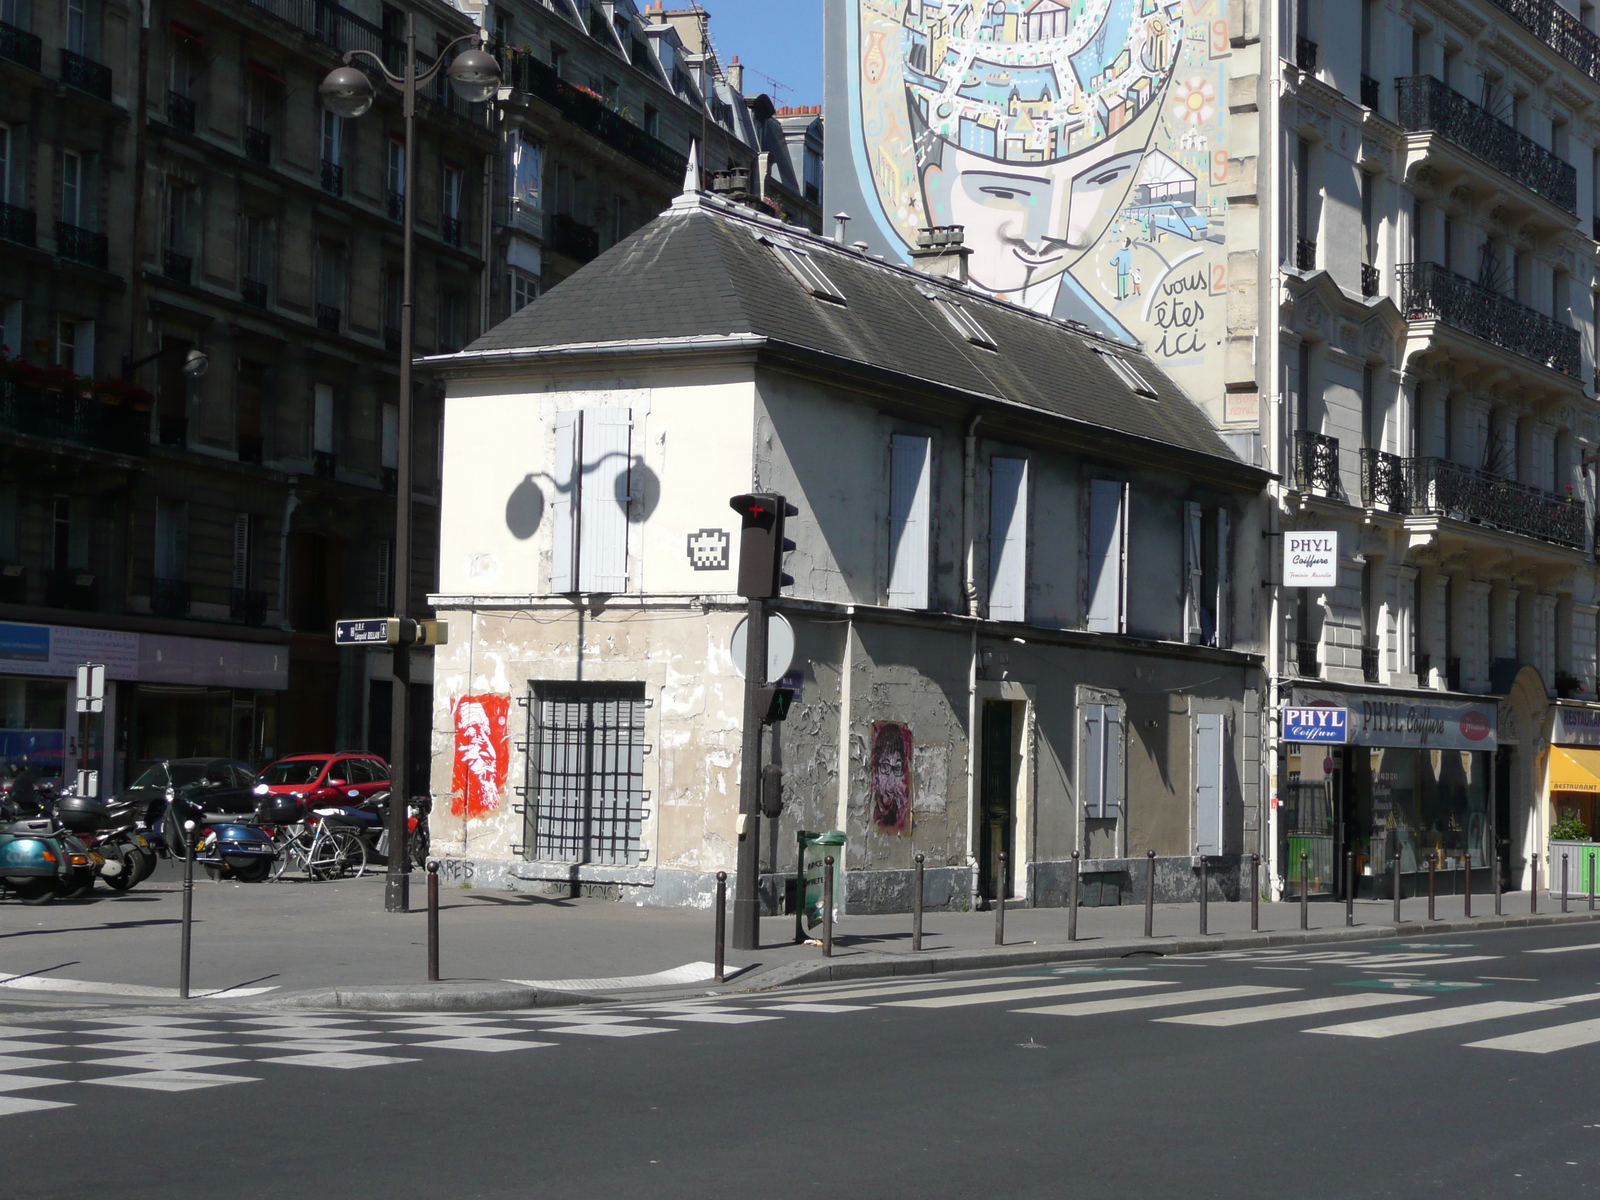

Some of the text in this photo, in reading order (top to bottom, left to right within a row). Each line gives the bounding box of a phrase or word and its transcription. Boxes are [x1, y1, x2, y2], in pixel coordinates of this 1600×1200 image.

[1212, 20, 1228, 52] 9
[1213, 150, 1229, 182] 9
[1162, 270, 1207, 297] vous
[1212, 264, 1227, 291] 2
[1154, 297, 1205, 329] êtes
[1154, 328, 1207, 358] ici
[1290, 539, 1333, 552] PHYL
[1292, 554, 1329, 569] Coiffure
[1286, 709, 1344, 728] PHYL
[1362, 700, 1445, 744] PHYL Coiffure
[1563, 709, 1600, 728] RESTAURA
[1291, 726, 1338, 740] Coiffure
[1554, 783, 1598, 791] RESTAURANT
